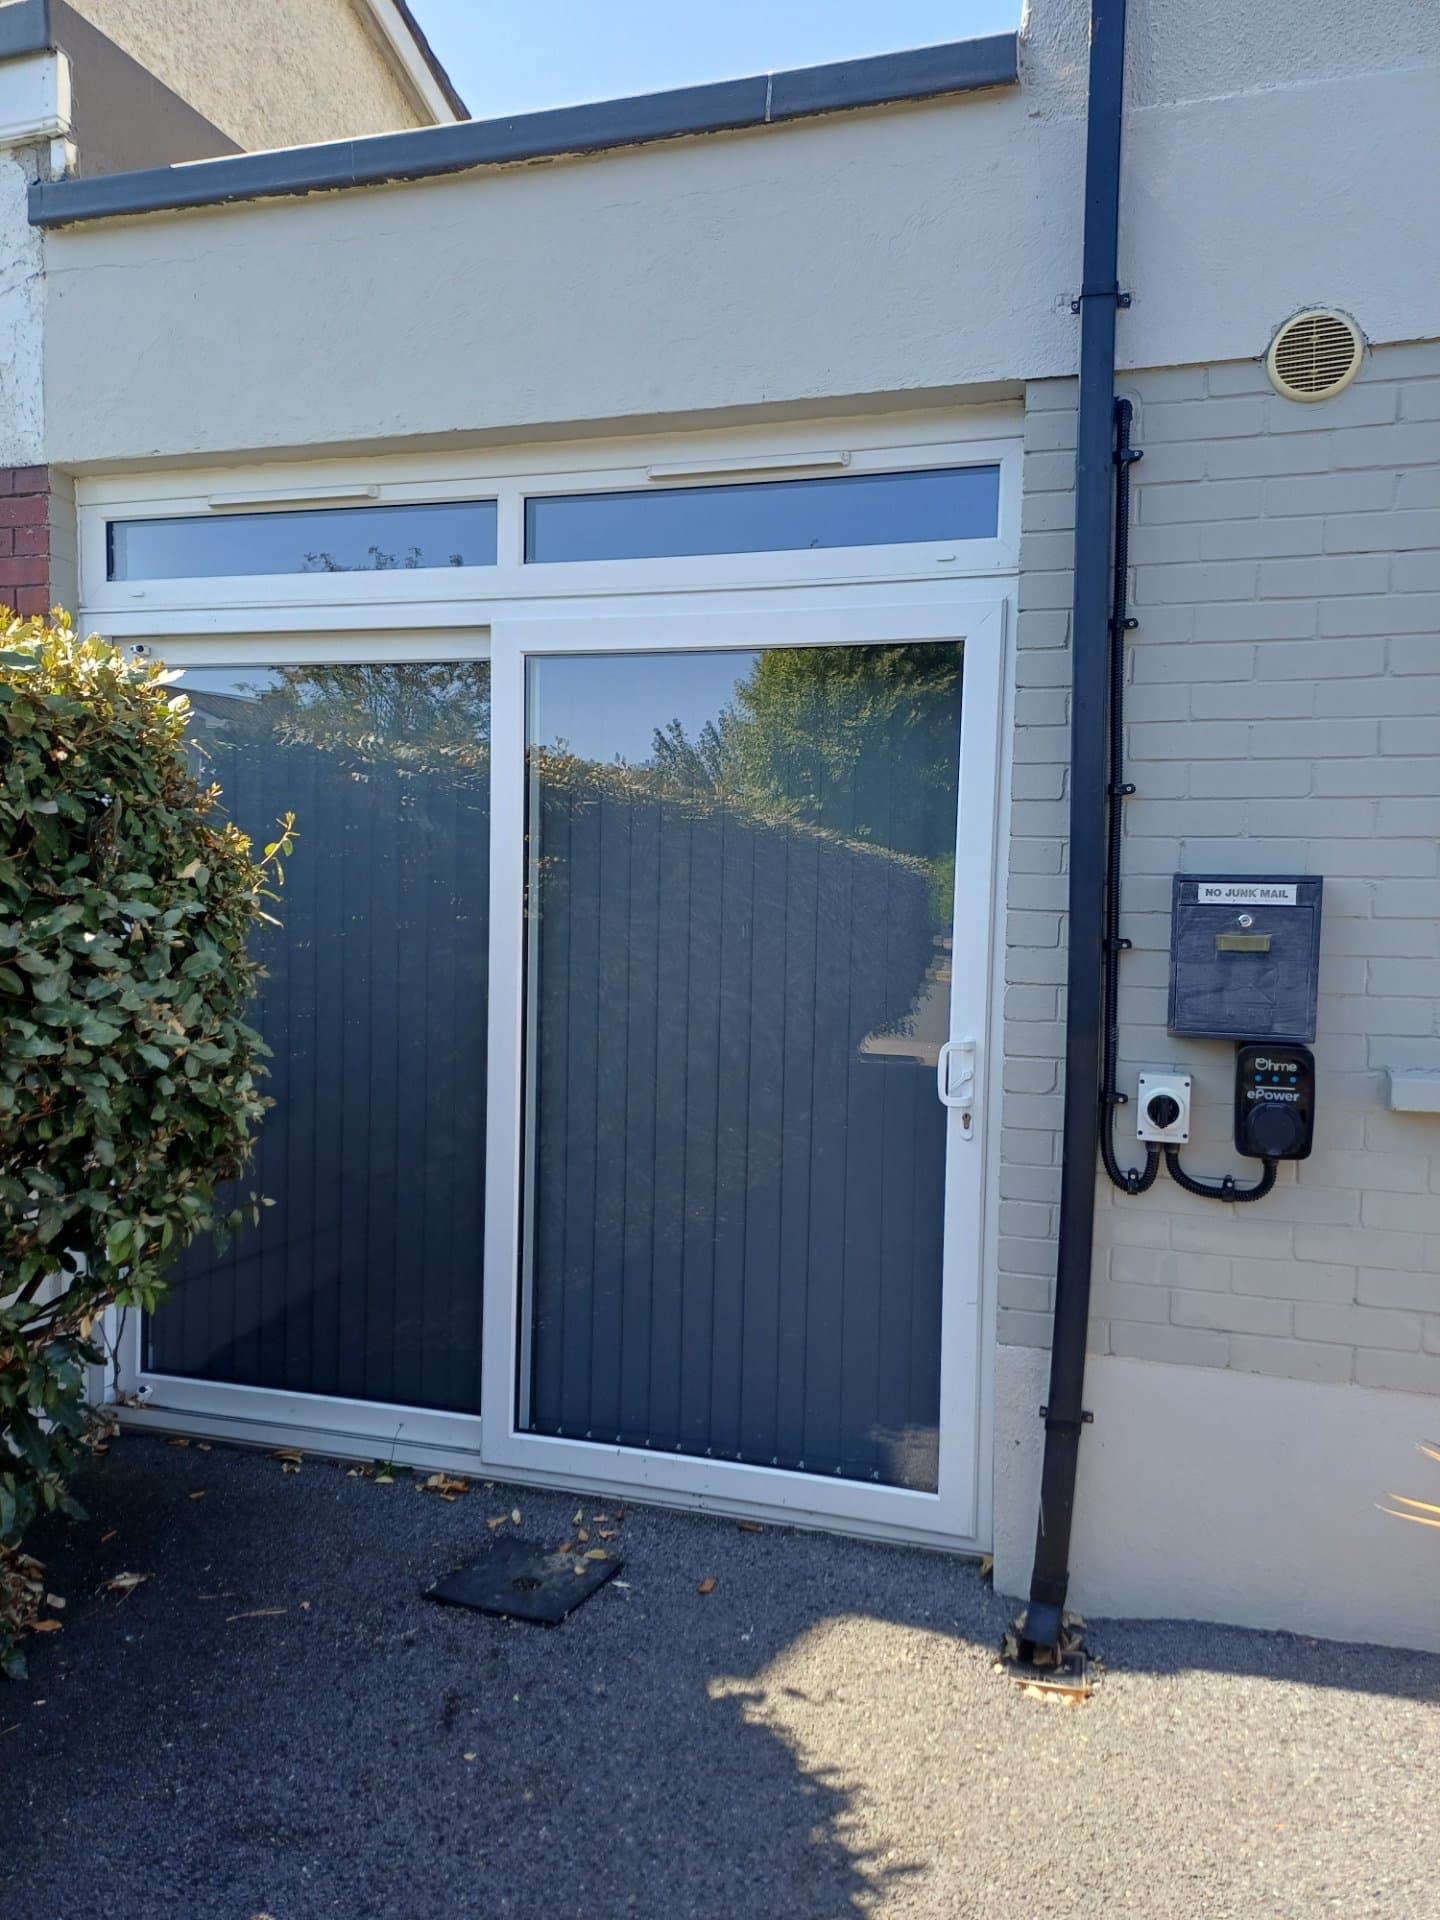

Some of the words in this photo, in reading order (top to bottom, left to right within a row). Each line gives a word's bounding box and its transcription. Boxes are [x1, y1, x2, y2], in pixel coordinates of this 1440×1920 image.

[1205, 888, 1222, 897] NO
[1225, 888, 1257, 898] JUNK
[1260, 889, 1289, 898] MAIL
[1255, 1057, 1298, 1072] Ohme
[1247, 1089, 1299, 1102] ePower
